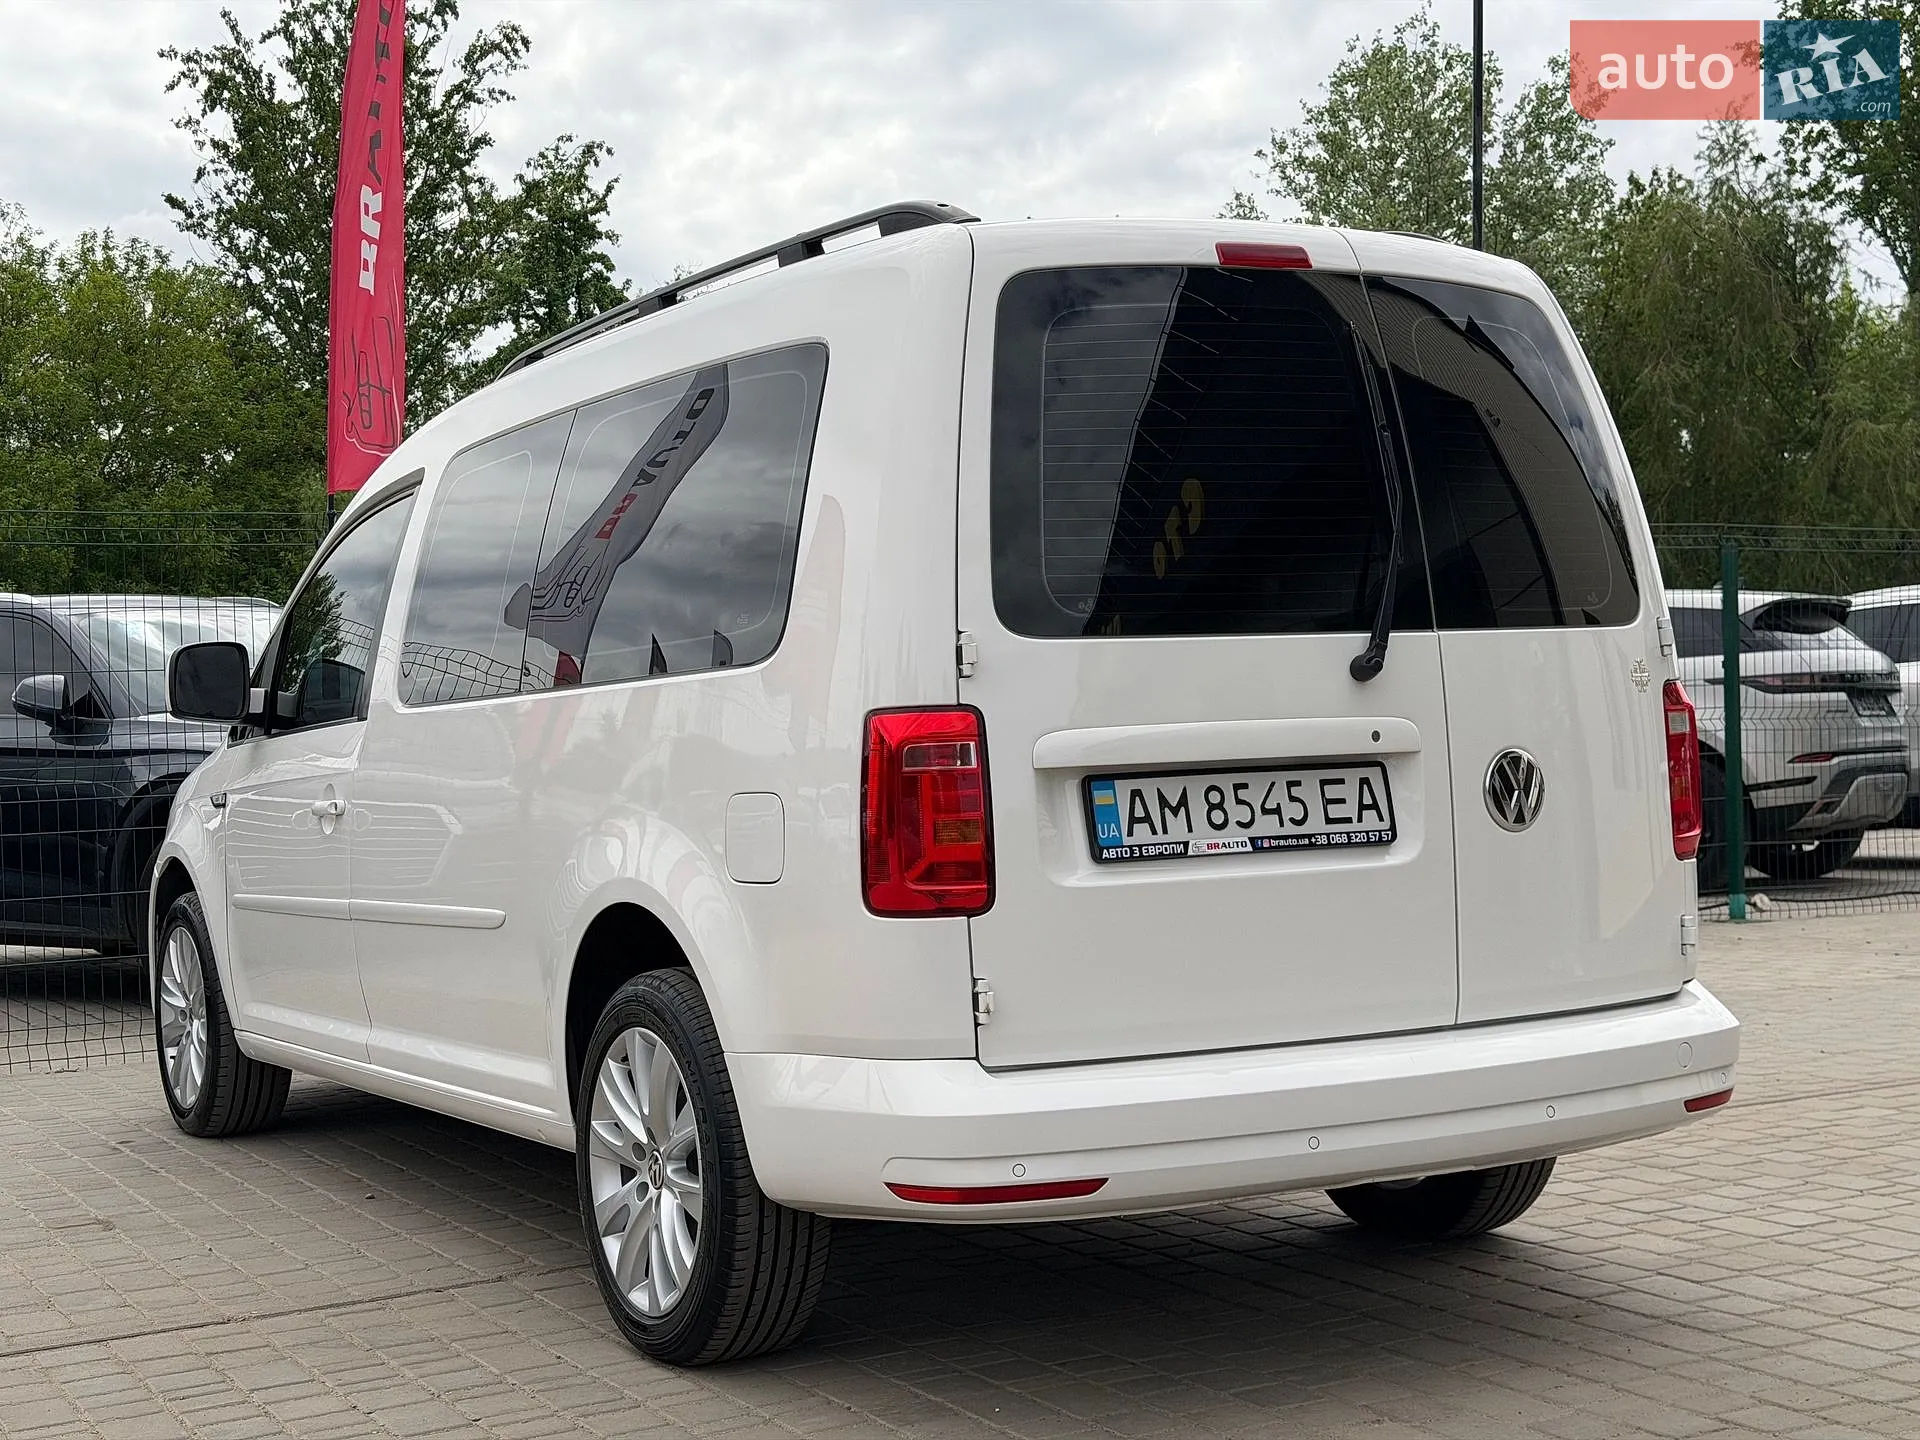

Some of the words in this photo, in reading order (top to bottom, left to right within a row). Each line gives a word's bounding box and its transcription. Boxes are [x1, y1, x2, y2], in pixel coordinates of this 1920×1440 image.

[1126, 785, 1194, 838] AM
[1203, 780, 1309, 832] 8545
[1318, 776, 1385, 826] EA
[1098, 822, 1120, 839] UA
[1206, 840, 1248, 851] BRAUTO
[1270, 837, 1309, 847] brauto.ua
[1310, 834, 1328, 845] +38
[1329, 833, 1348, 844] 068
[1350, 832, 1367, 843] 320
[1369, 831, 1380, 842] 57
[1381, 831, 1392, 841] 57
[1101, 847, 1131, 860] АВТО
